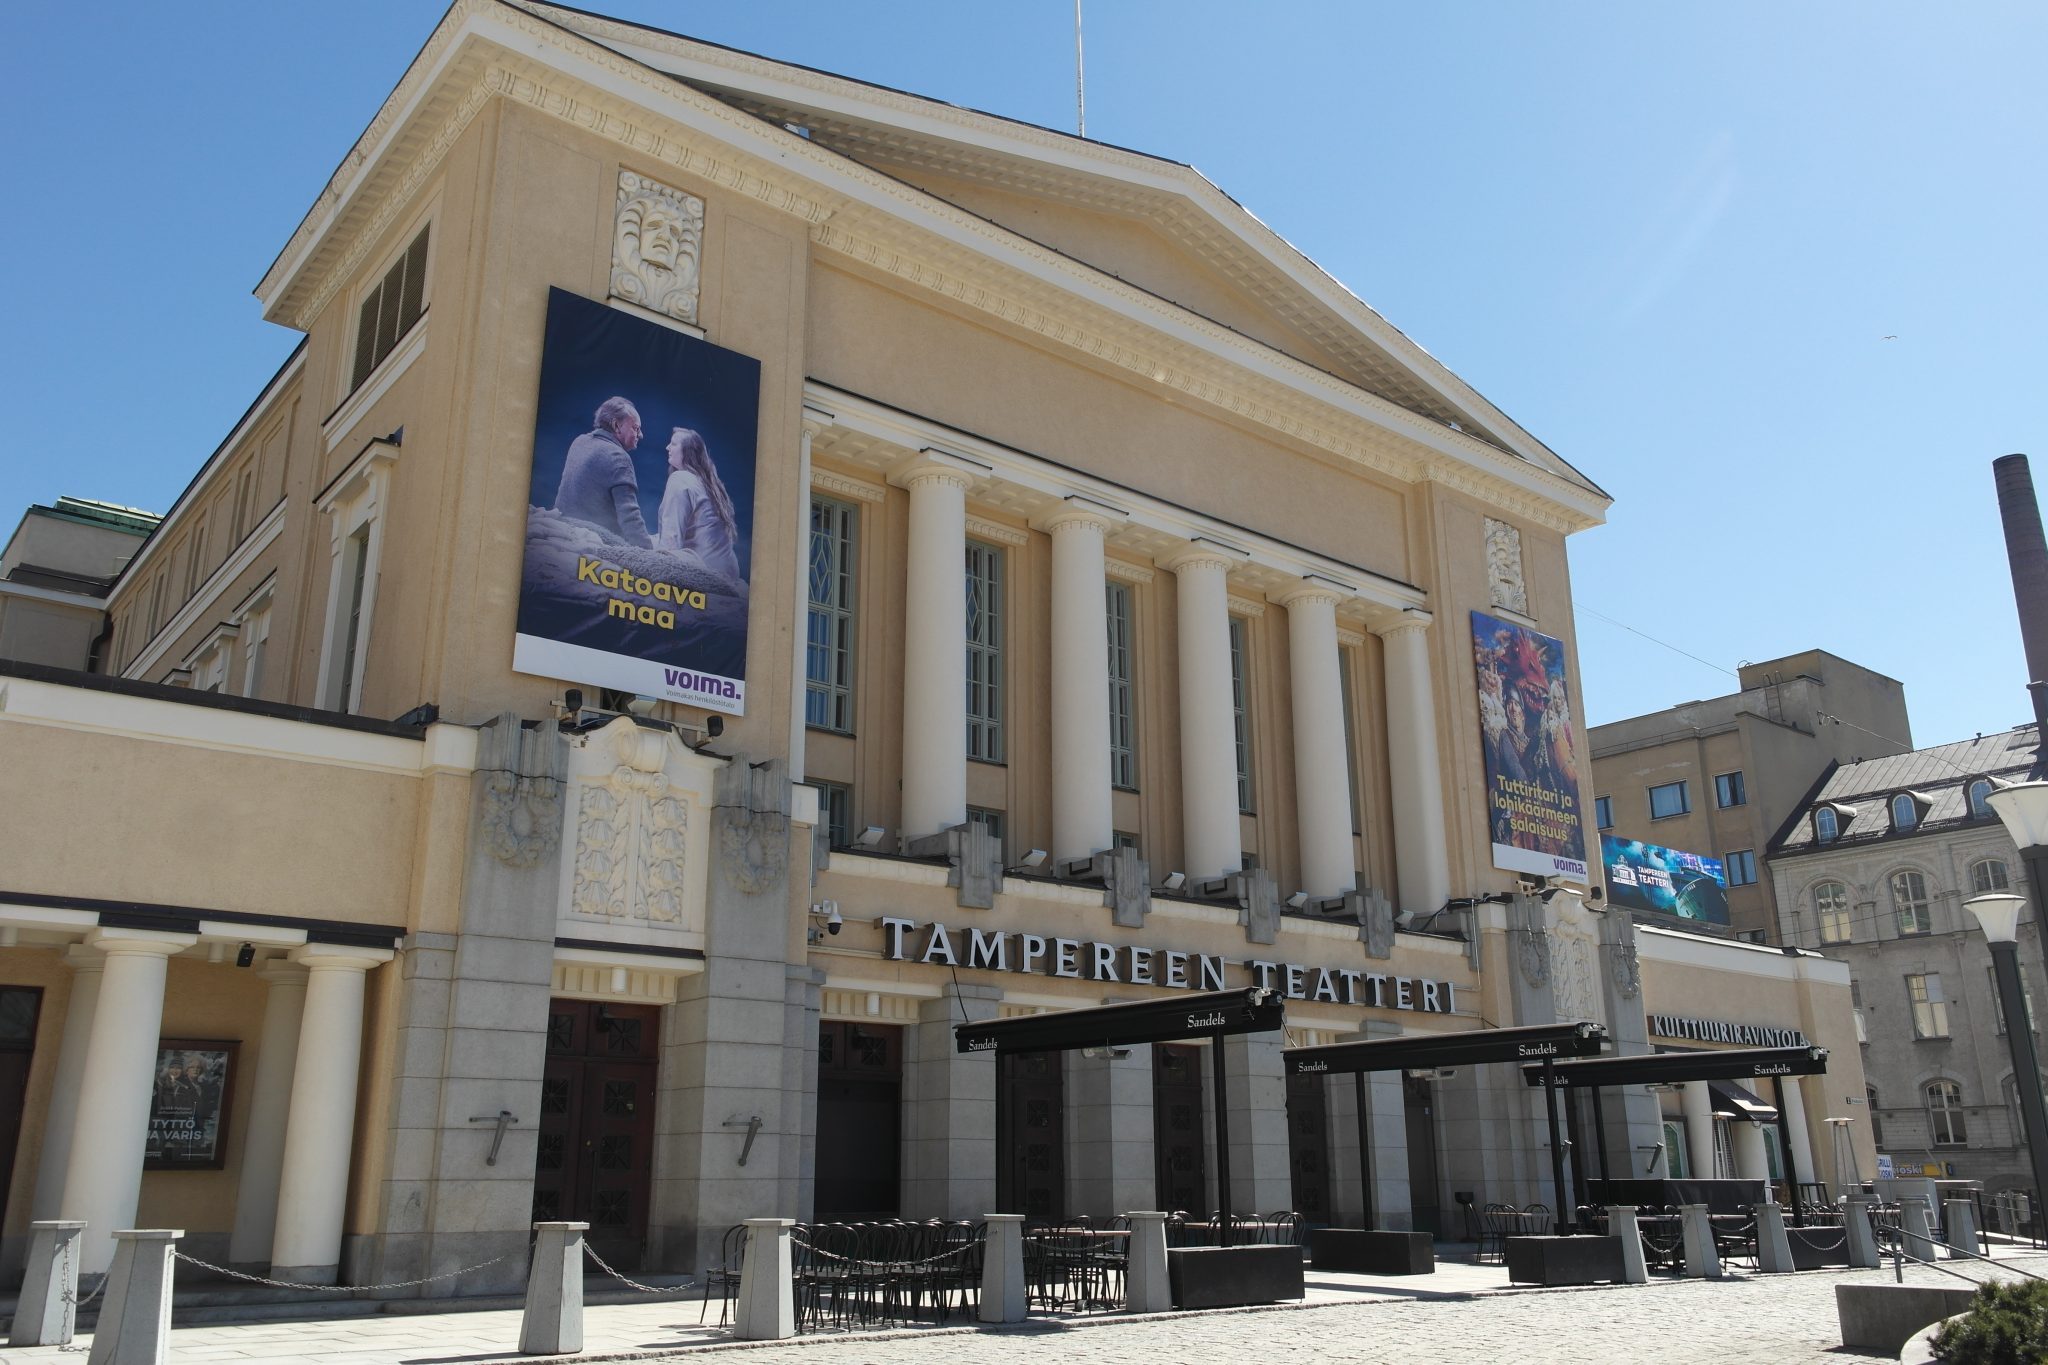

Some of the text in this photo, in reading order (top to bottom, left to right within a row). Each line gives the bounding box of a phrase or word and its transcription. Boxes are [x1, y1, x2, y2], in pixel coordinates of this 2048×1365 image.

[578, 556, 707, 610] Katoava
[608, 598, 676, 630] maa
[664, 668, 742, 700] voima.
[1496, 774, 1573, 809] Tuttiritari ja
[1494, 791, 1578, 826] lohikäärmeen
[1509, 817, 1569, 842] salaisuus
[1637, 865, 1668, 878] TAMPEREEN
[1638, 874, 1669, 888] TEATTERI
[880, 915, 1456, 1014] TAMPEREEN TEATTERI
[1187, 1012, 1226, 1028] Sandels
[1653, 1015, 1807, 1048] KULTTUURIRAVINTOLA
[968, 1037, 998, 1051] Sandels
[1518, 1042, 1558, 1056] Sandels
[1298, 1060, 1328, 1072] Sandels
[1754, 1063, 1791, 1076] Sandels
[1538, 1075, 1569, 1086] Sdels
[152, 1116, 196, 1129] TYTTÖ
[163, 1130, 203, 1140] VARIS
